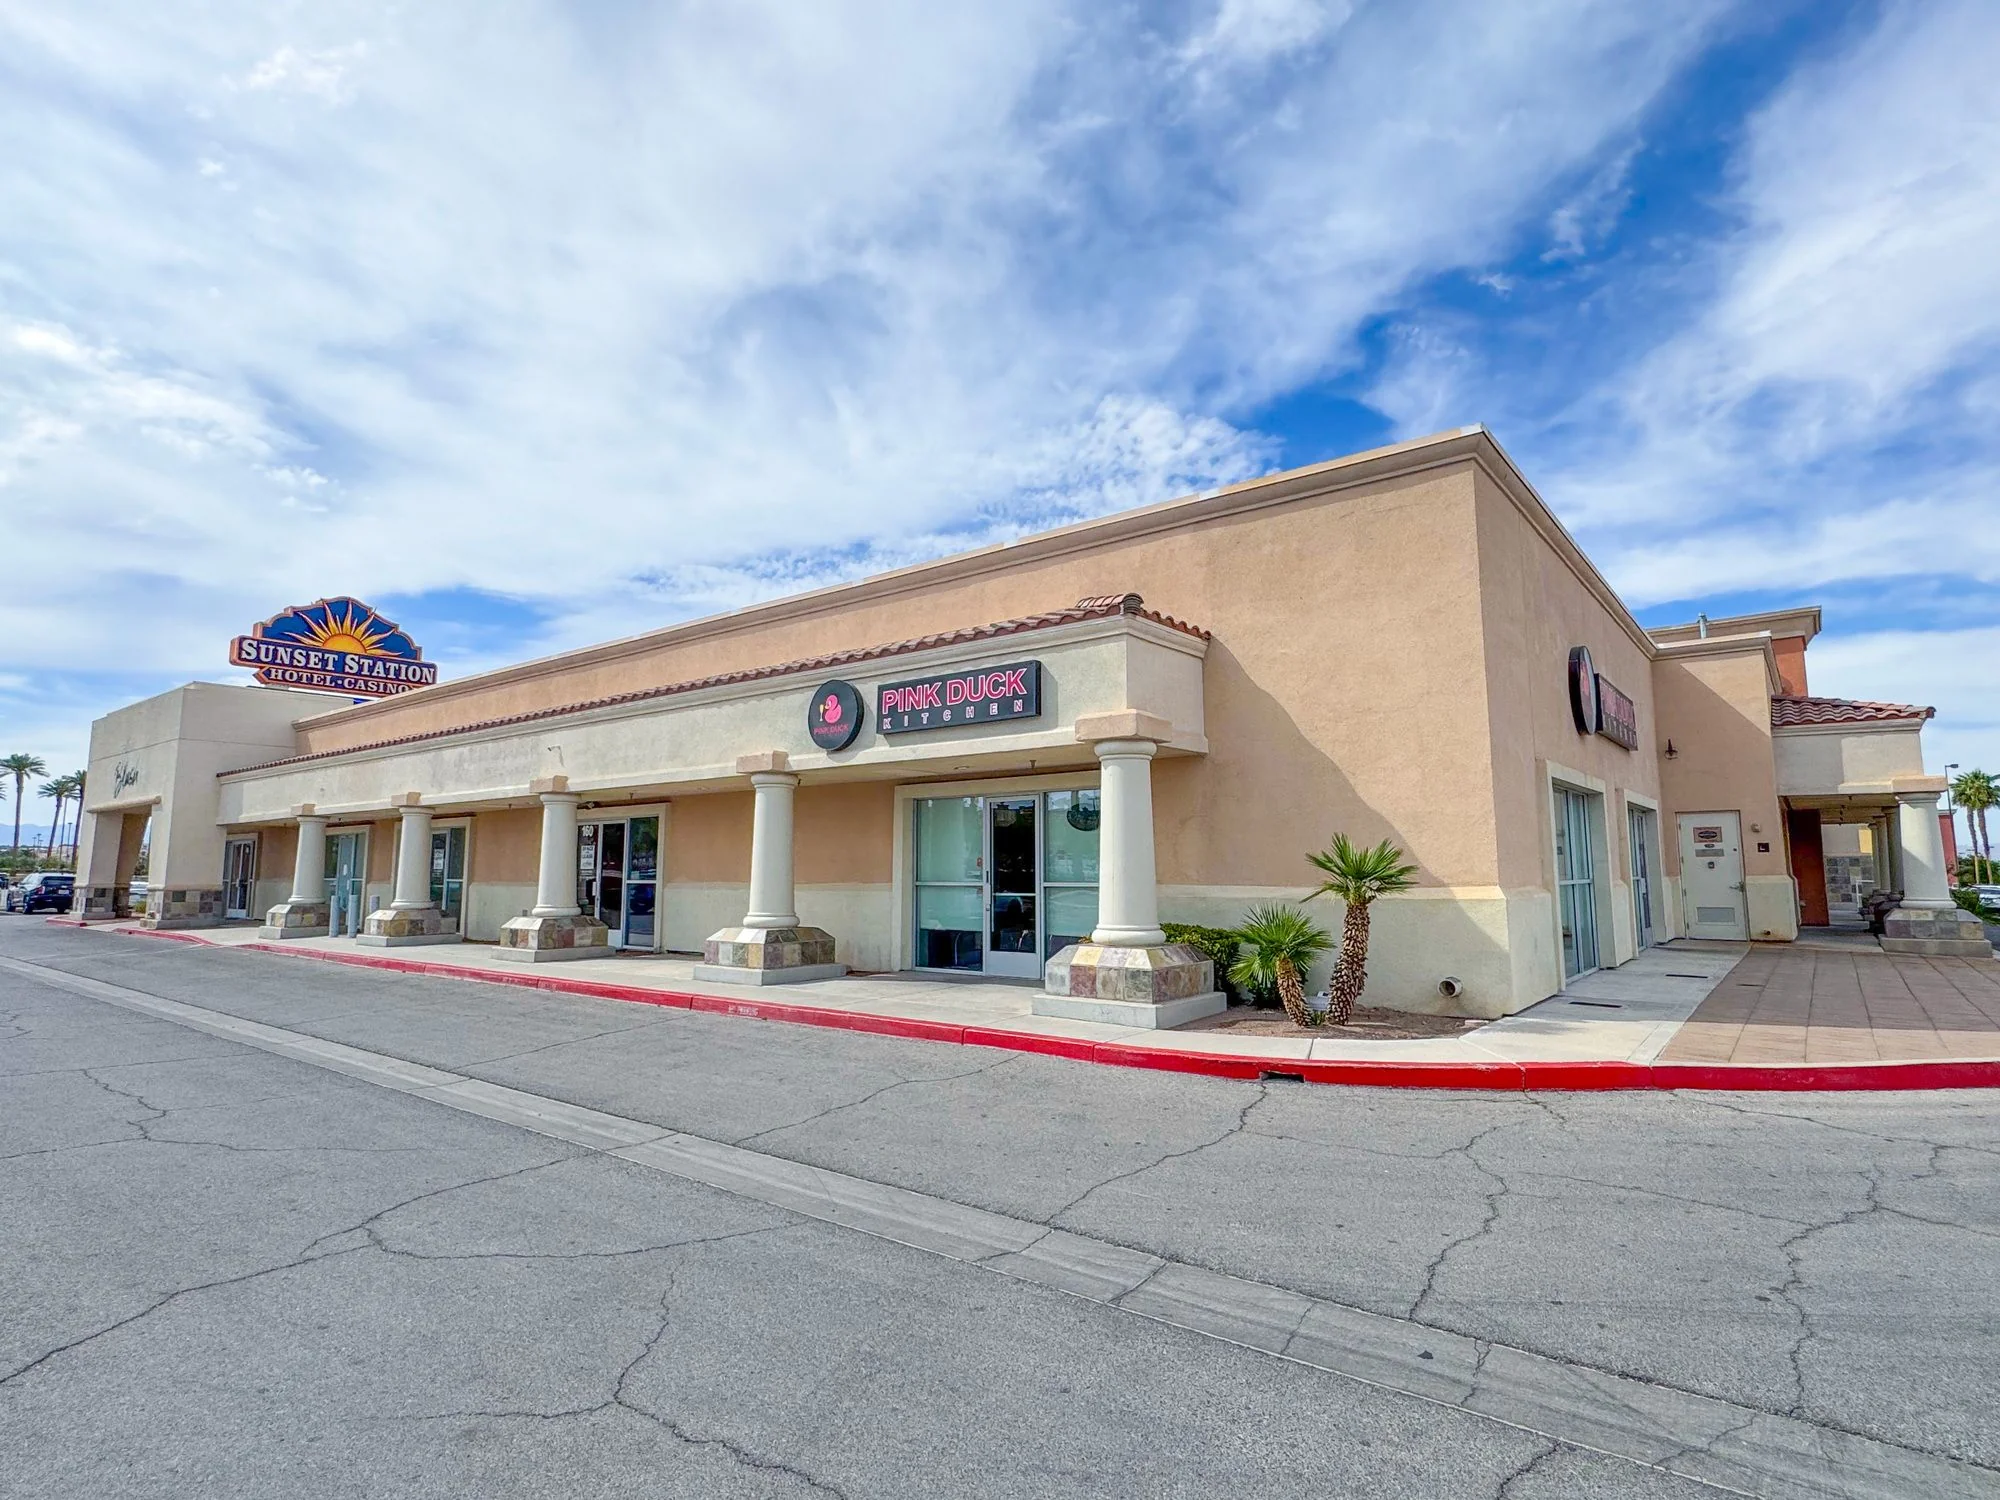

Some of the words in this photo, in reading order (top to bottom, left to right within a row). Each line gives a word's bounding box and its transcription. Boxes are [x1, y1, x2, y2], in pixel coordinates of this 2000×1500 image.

[241, 639, 339, 671] SUNSET
[344, 654, 435, 684] STATION
[882, 682, 943, 715] PINK
[946, 668, 1028, 706] DUCK
[882, 699, 1023, 730] KITCHEN
